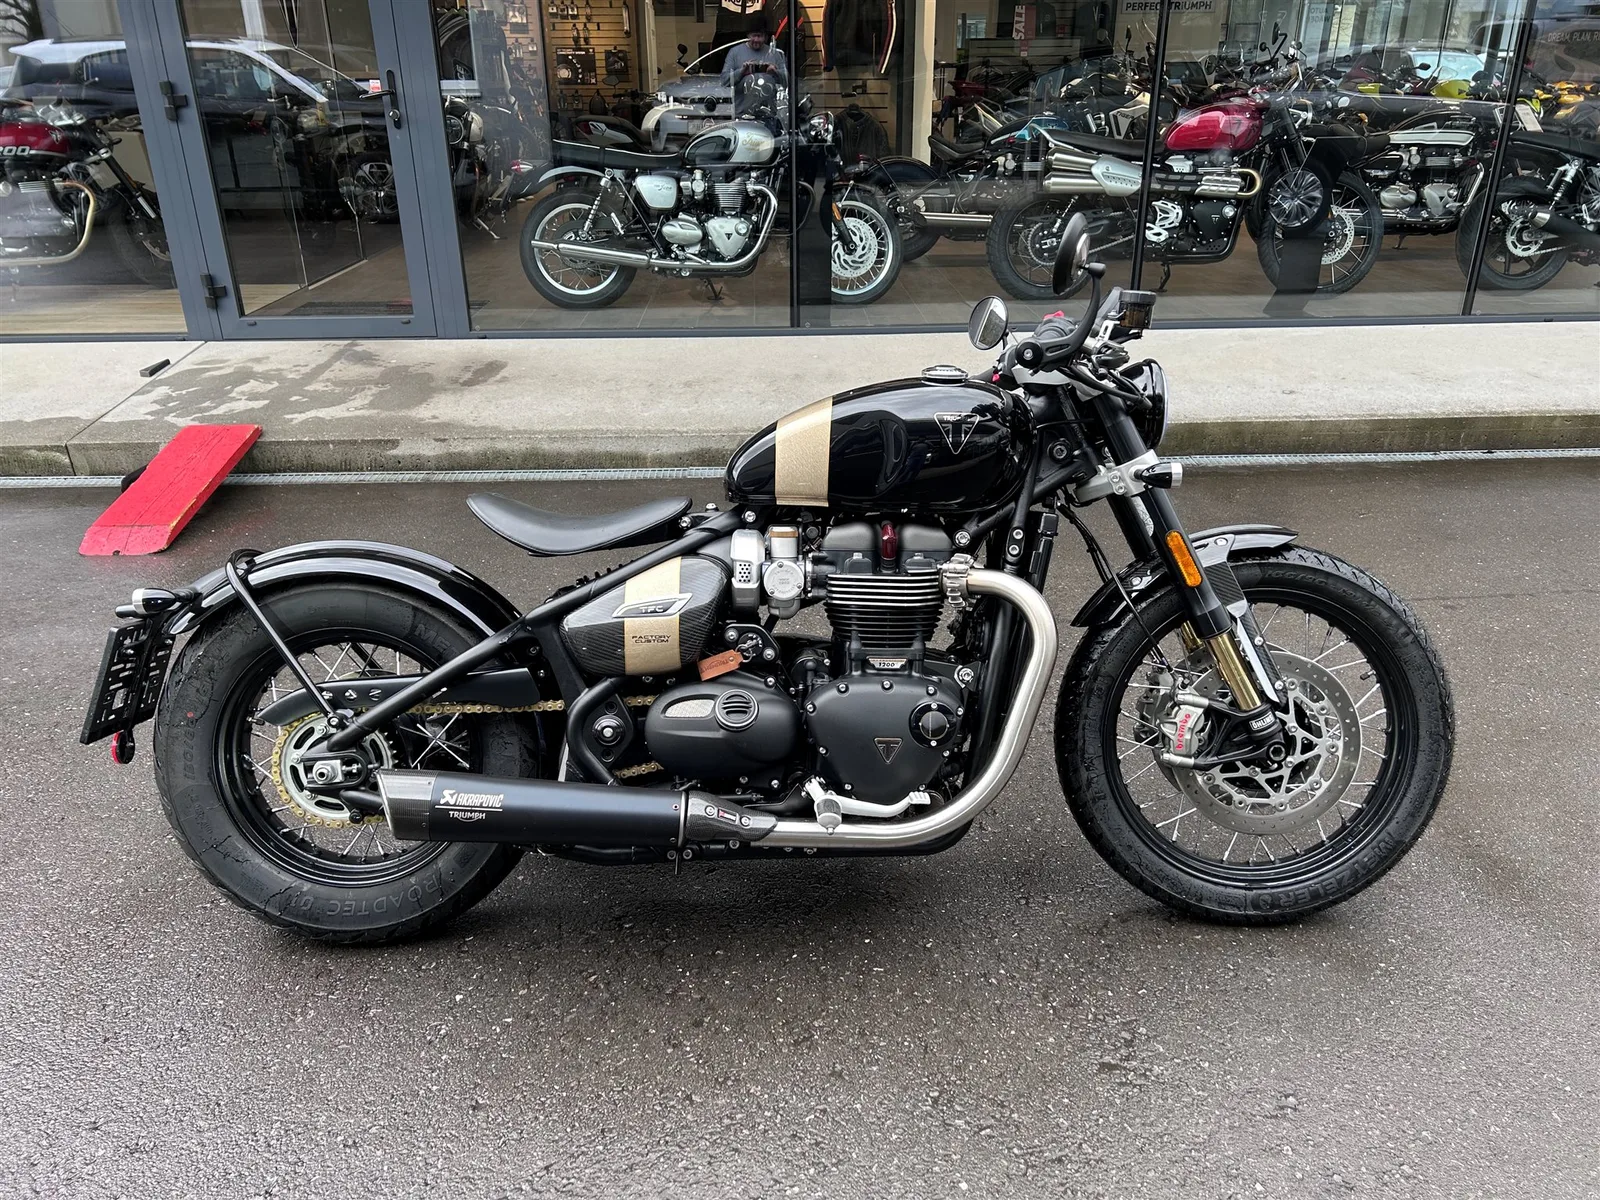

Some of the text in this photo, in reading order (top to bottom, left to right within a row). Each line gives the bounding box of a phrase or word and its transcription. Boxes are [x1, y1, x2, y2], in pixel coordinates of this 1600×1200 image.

[1013, 5, 1026, 40] SALE
[1126, 2, 1161, 11] PERFEC
[640, 605, 664, 613] TFC
[1175, 713, 1191, 750] brembo
[449, 811, 486, 821] TRIUMPH
[1279, 831, 1397, 908] METZELER
[327, 874, 439, 916] ROADTEC
